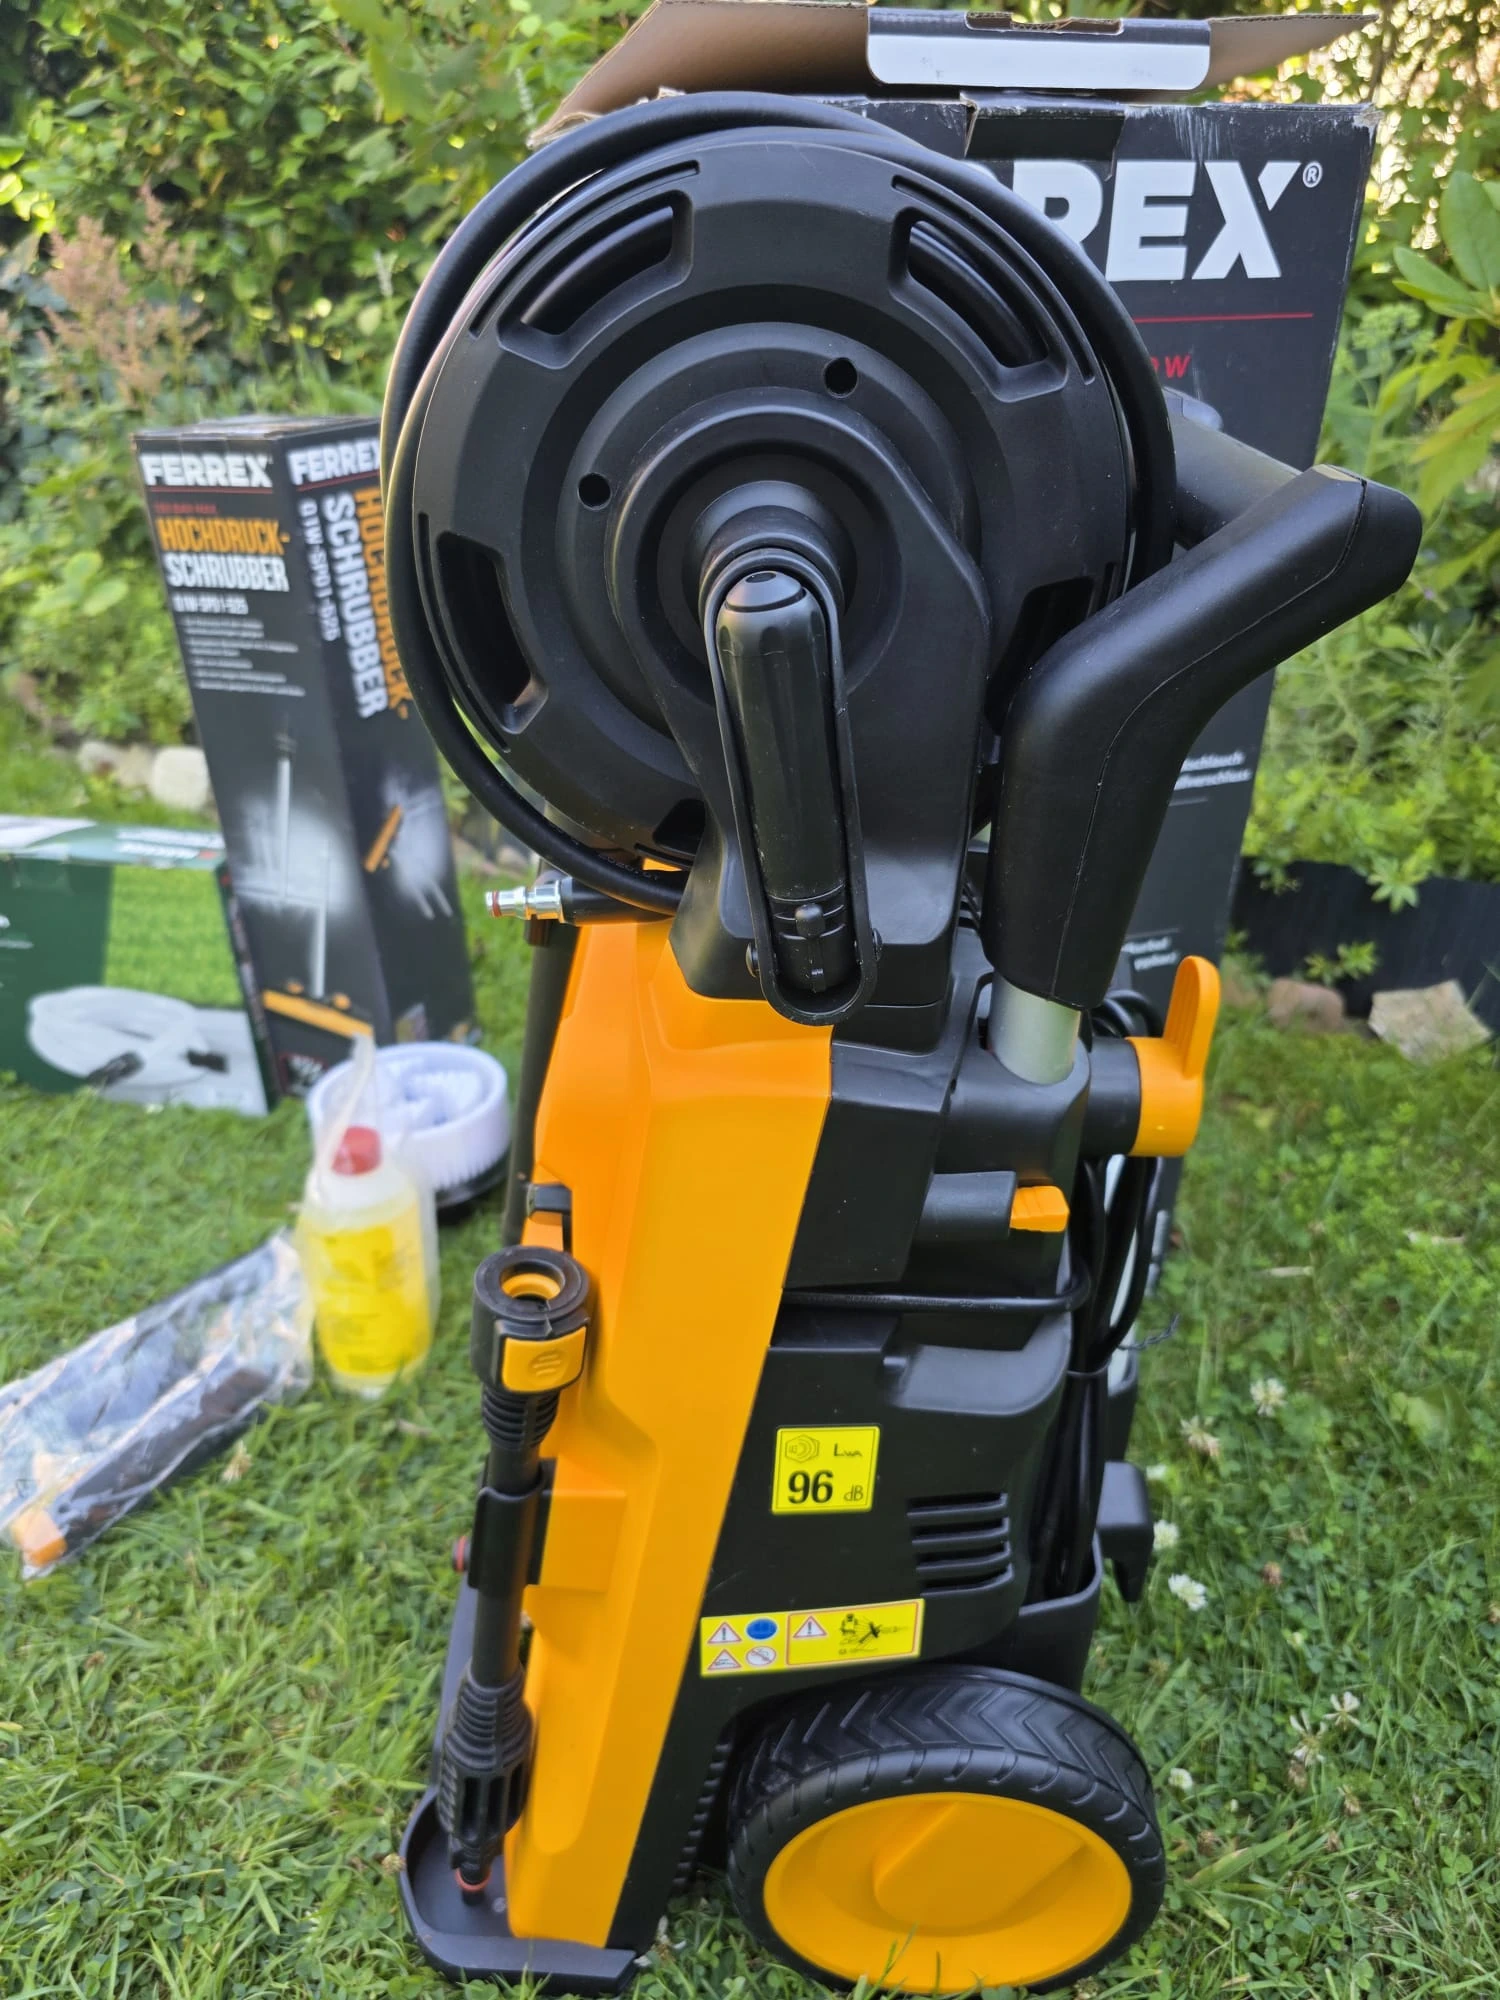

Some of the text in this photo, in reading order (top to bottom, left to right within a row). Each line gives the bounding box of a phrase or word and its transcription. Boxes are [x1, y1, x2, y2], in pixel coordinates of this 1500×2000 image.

[140, 453, 273, 488] FERREX
[156, 518, 291, 554] HOCHDRUCK-
[163, 553, 290, 592] SCHRUBBER
[322, 492, 389, 720] SCHRUBBER
[787, 1469, 864, 1505] 96 dB
